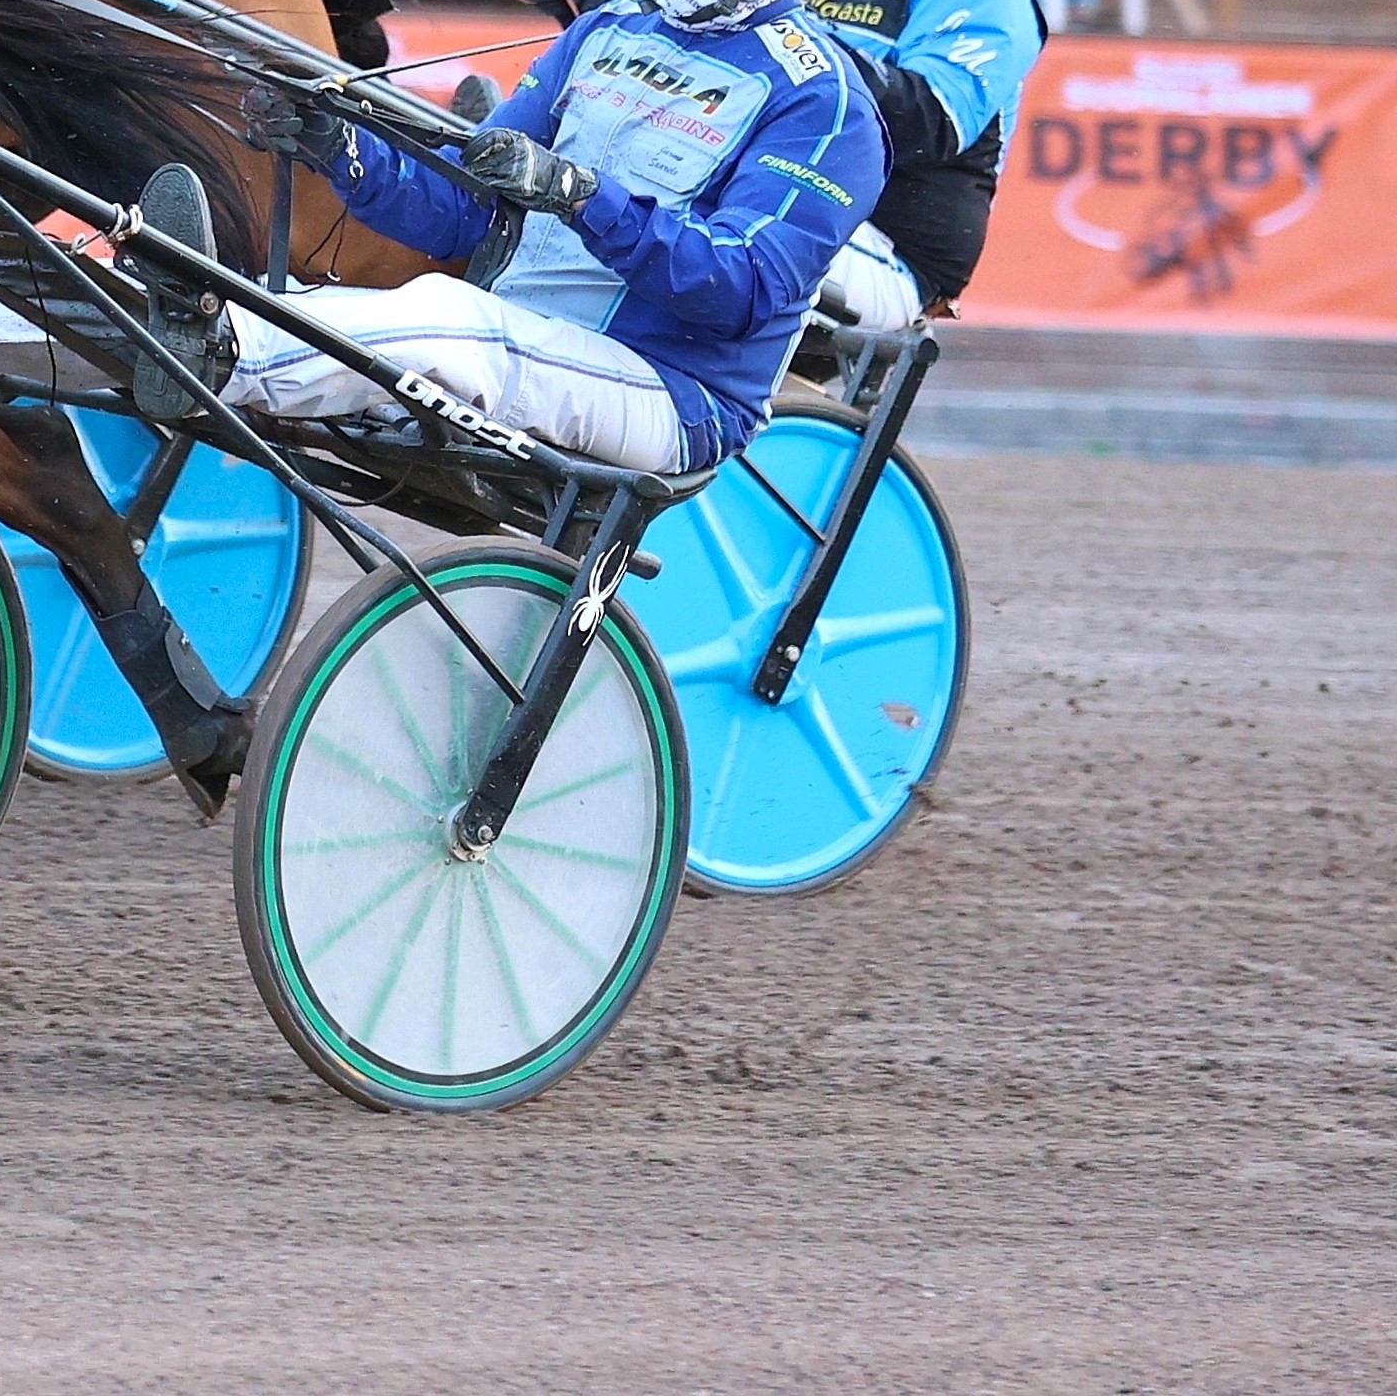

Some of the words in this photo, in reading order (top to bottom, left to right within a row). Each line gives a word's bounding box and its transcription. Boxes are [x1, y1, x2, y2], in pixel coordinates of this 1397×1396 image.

[757, 154, 854, 208] FINNFORM
[1028, 115, 1340, 187] DERBY
[394, 369, 538, 461] Ghost
